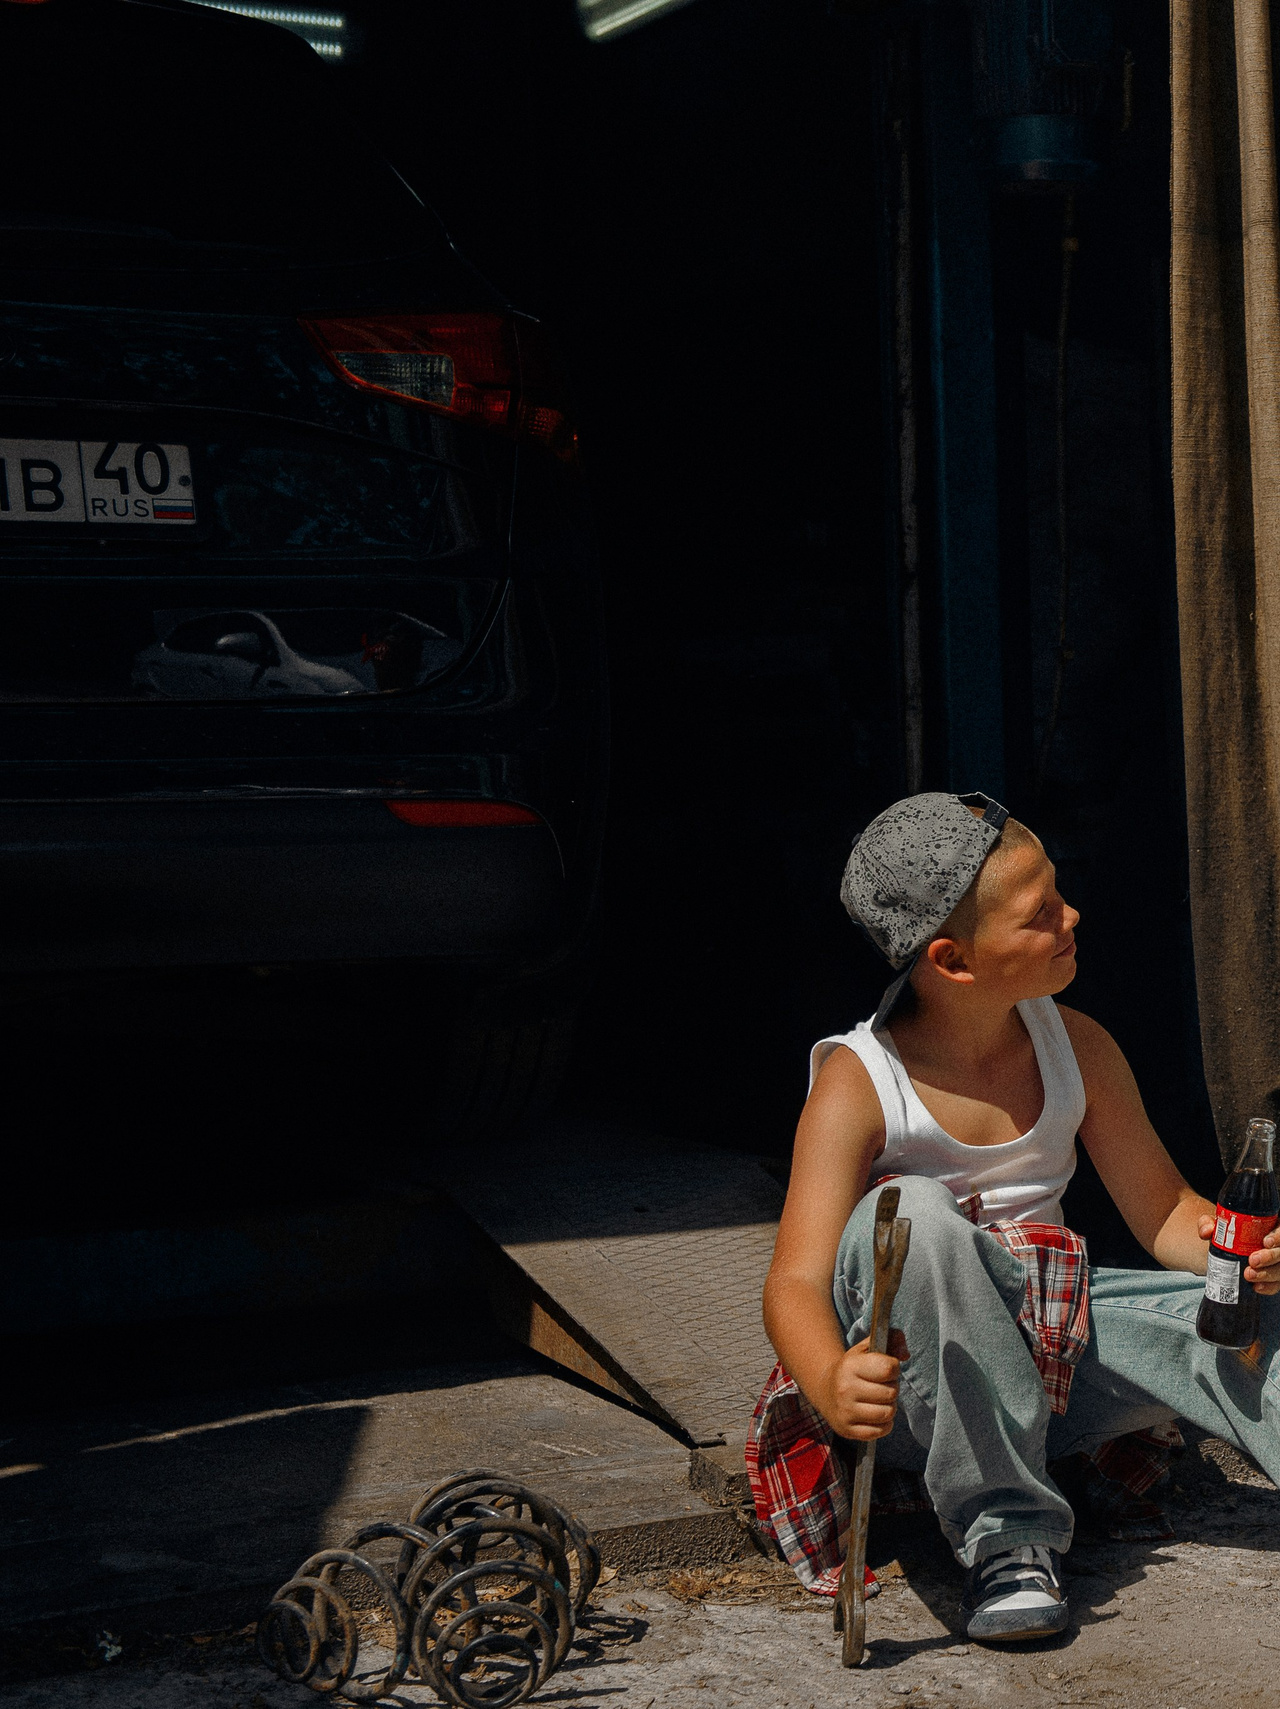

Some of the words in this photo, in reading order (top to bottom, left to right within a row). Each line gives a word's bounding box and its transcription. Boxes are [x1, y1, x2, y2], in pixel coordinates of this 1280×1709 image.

[0, 458, 64, 512] B
[94, 441, 169, 495] 40
[91, 498, 149, 517] RUS
